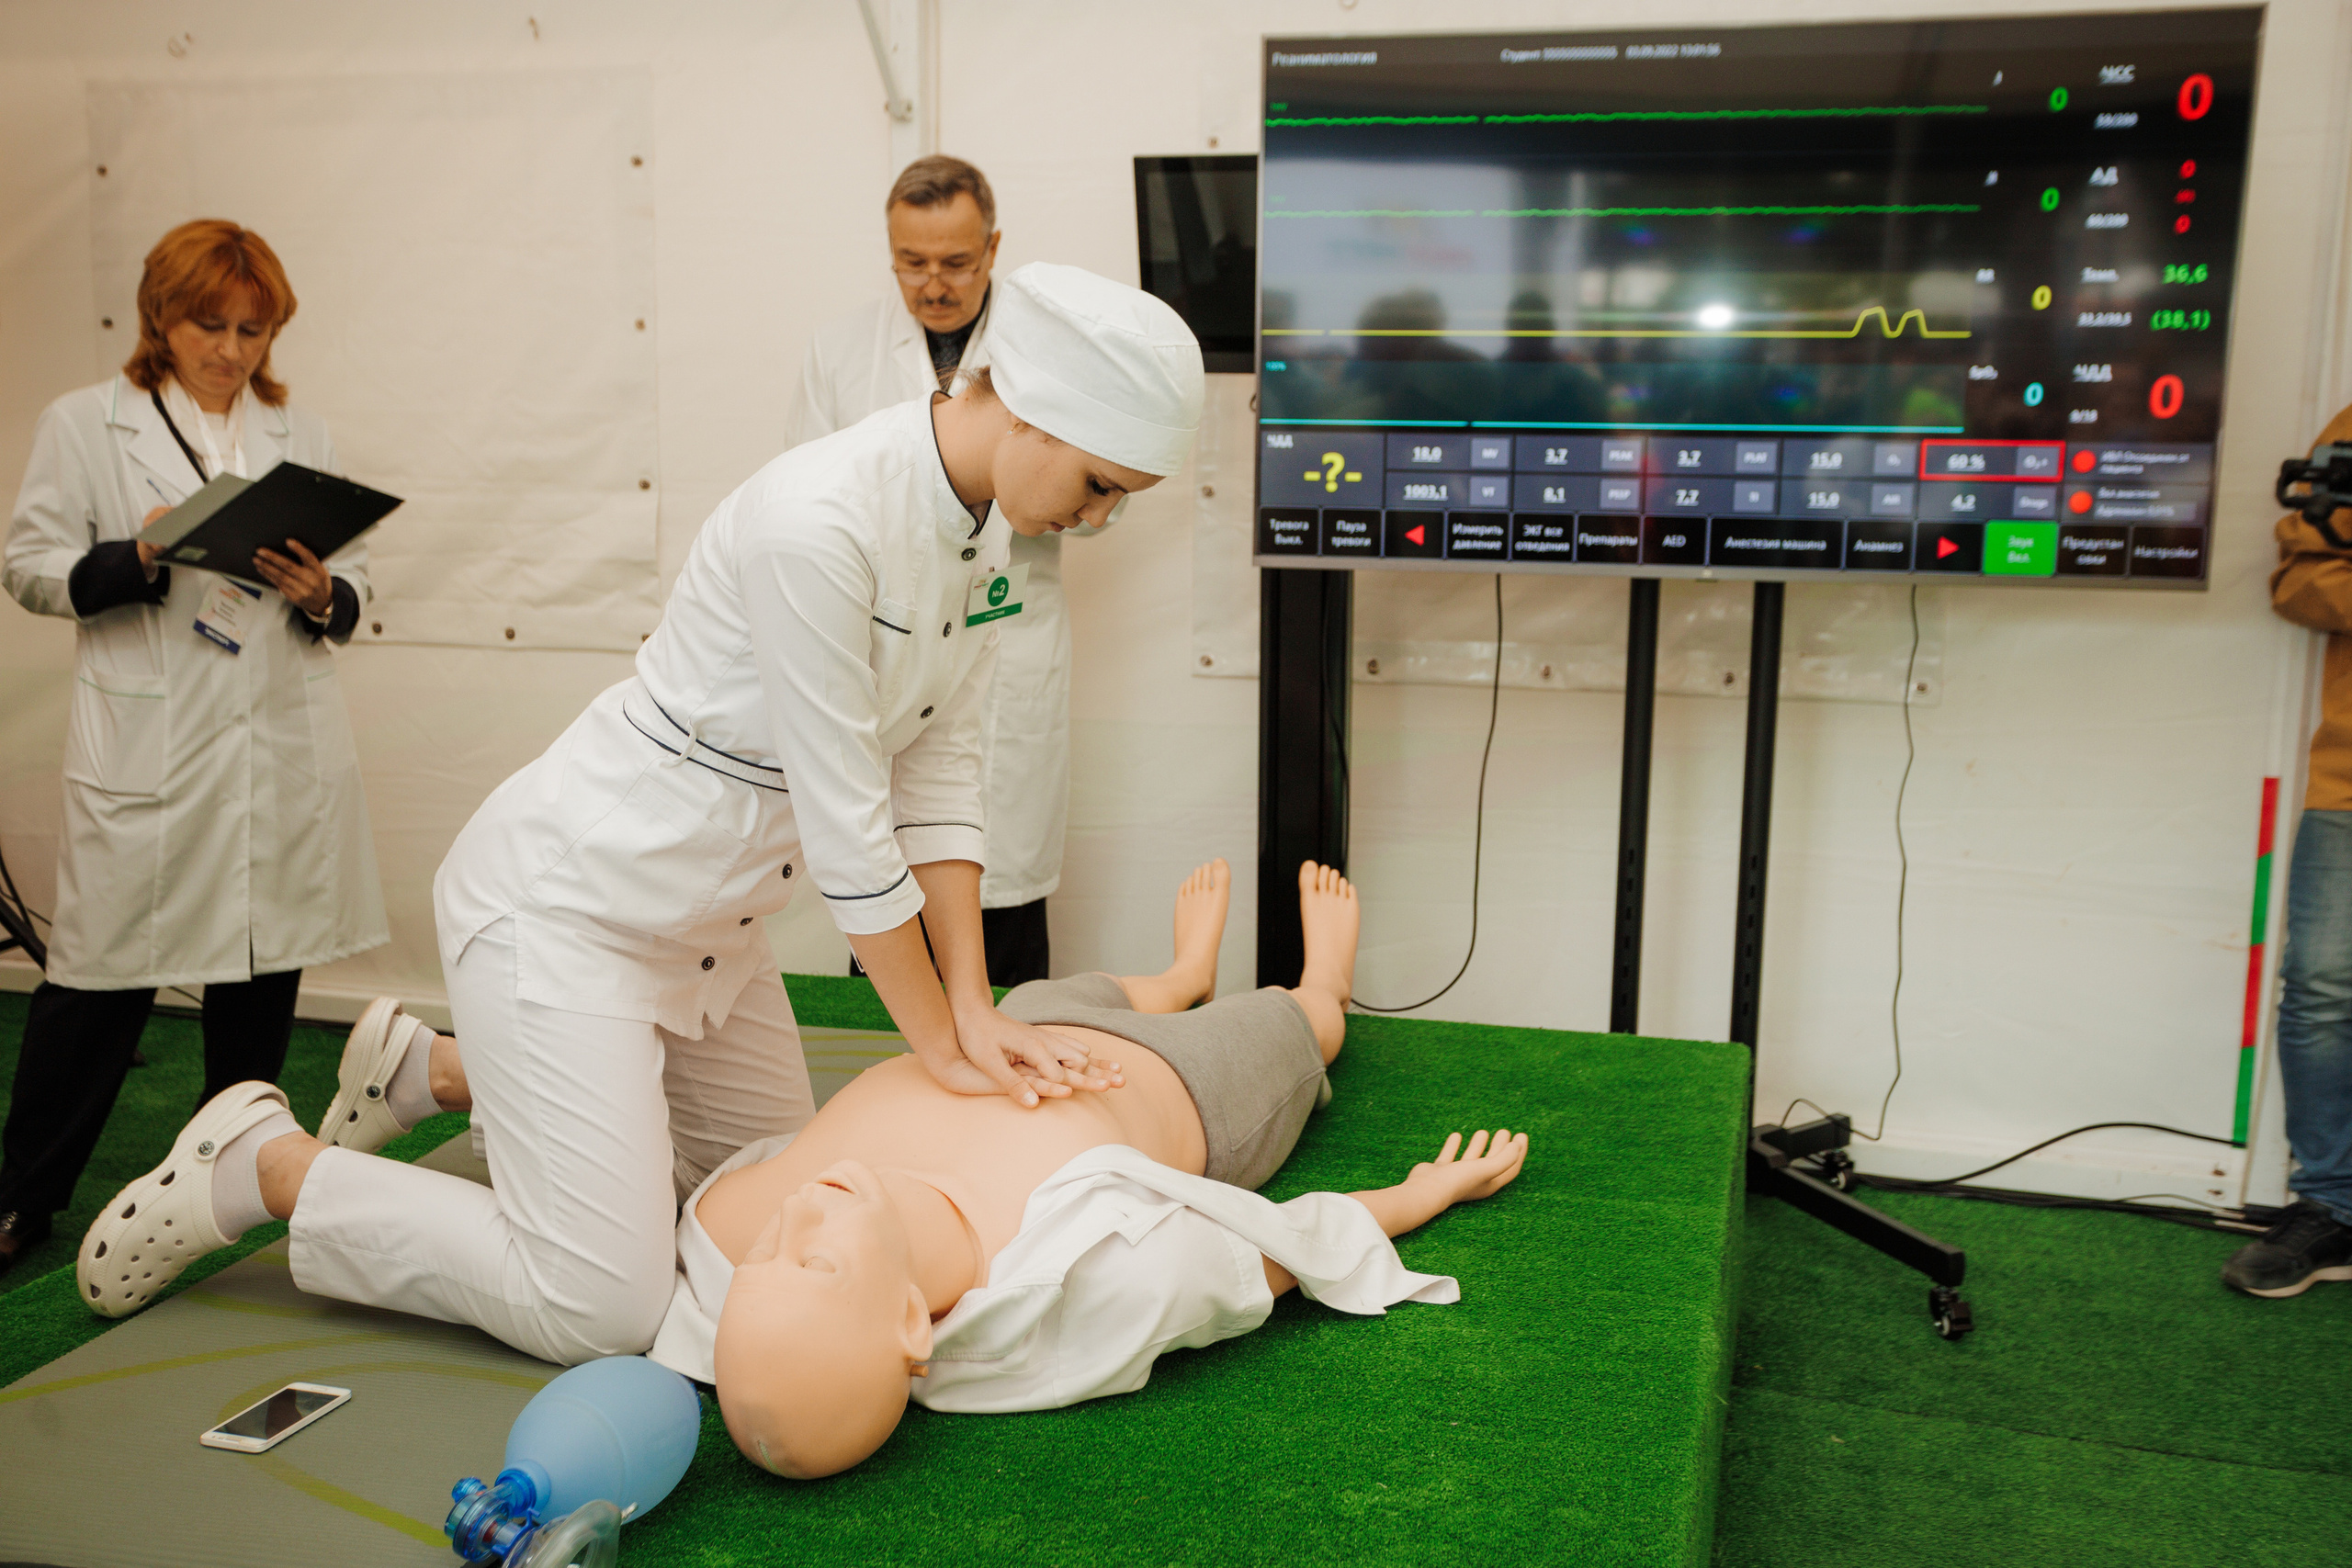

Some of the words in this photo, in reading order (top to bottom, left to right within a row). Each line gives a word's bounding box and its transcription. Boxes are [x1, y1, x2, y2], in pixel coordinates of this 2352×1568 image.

[2050, 87, 2068, 112] 0
[2177, 73, 2214, 120] 0
[2041, 186, 2060, 211] 0
[2031, 285, 2052, 310] 0
[2023, 382, 2044, 407] 0
[2149, 374, 2184, 419] 0
[1270, 518, 1309, 532] Тревога
[1336, 520, 1367, 535] Пауза
[1453, 523, 1504, 537] Измерить
[1522, 525, 1544, 537] ЭКГ
[1331, 536, 1372, 548] тревоги
[1453, 540, 1503, 551] давление
[1578, 532, 1638, 547] Препараты
